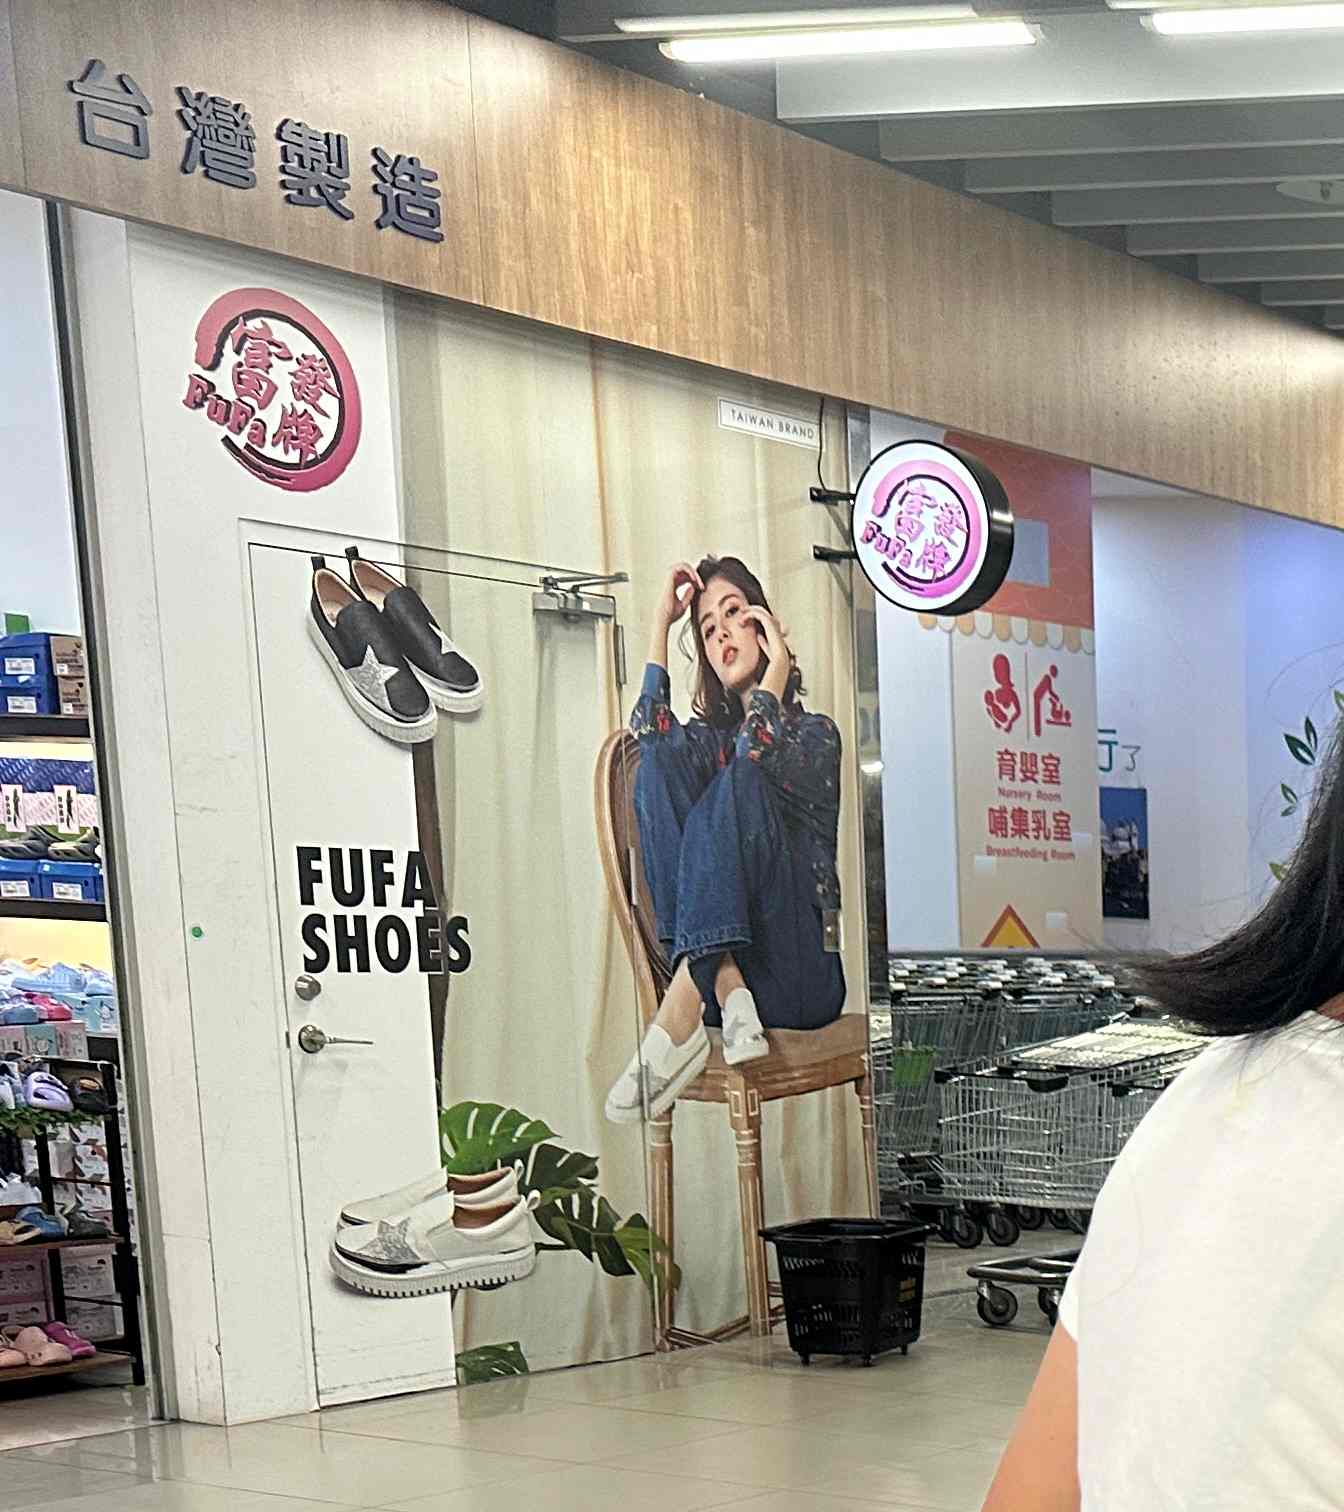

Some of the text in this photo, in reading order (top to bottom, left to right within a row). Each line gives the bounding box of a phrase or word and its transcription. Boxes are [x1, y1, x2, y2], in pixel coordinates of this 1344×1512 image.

[67, 58, 445, 244] 台灣製造
[730, 408, 815, 440] TAIWAN BRAND
[996, 748, 1061, 786] 育嬰室
[988, 806, 1072, 842] 哺集乳室
[296, 846, 437, 908] FUFA
[301, 912, 471, 974] SHOES
